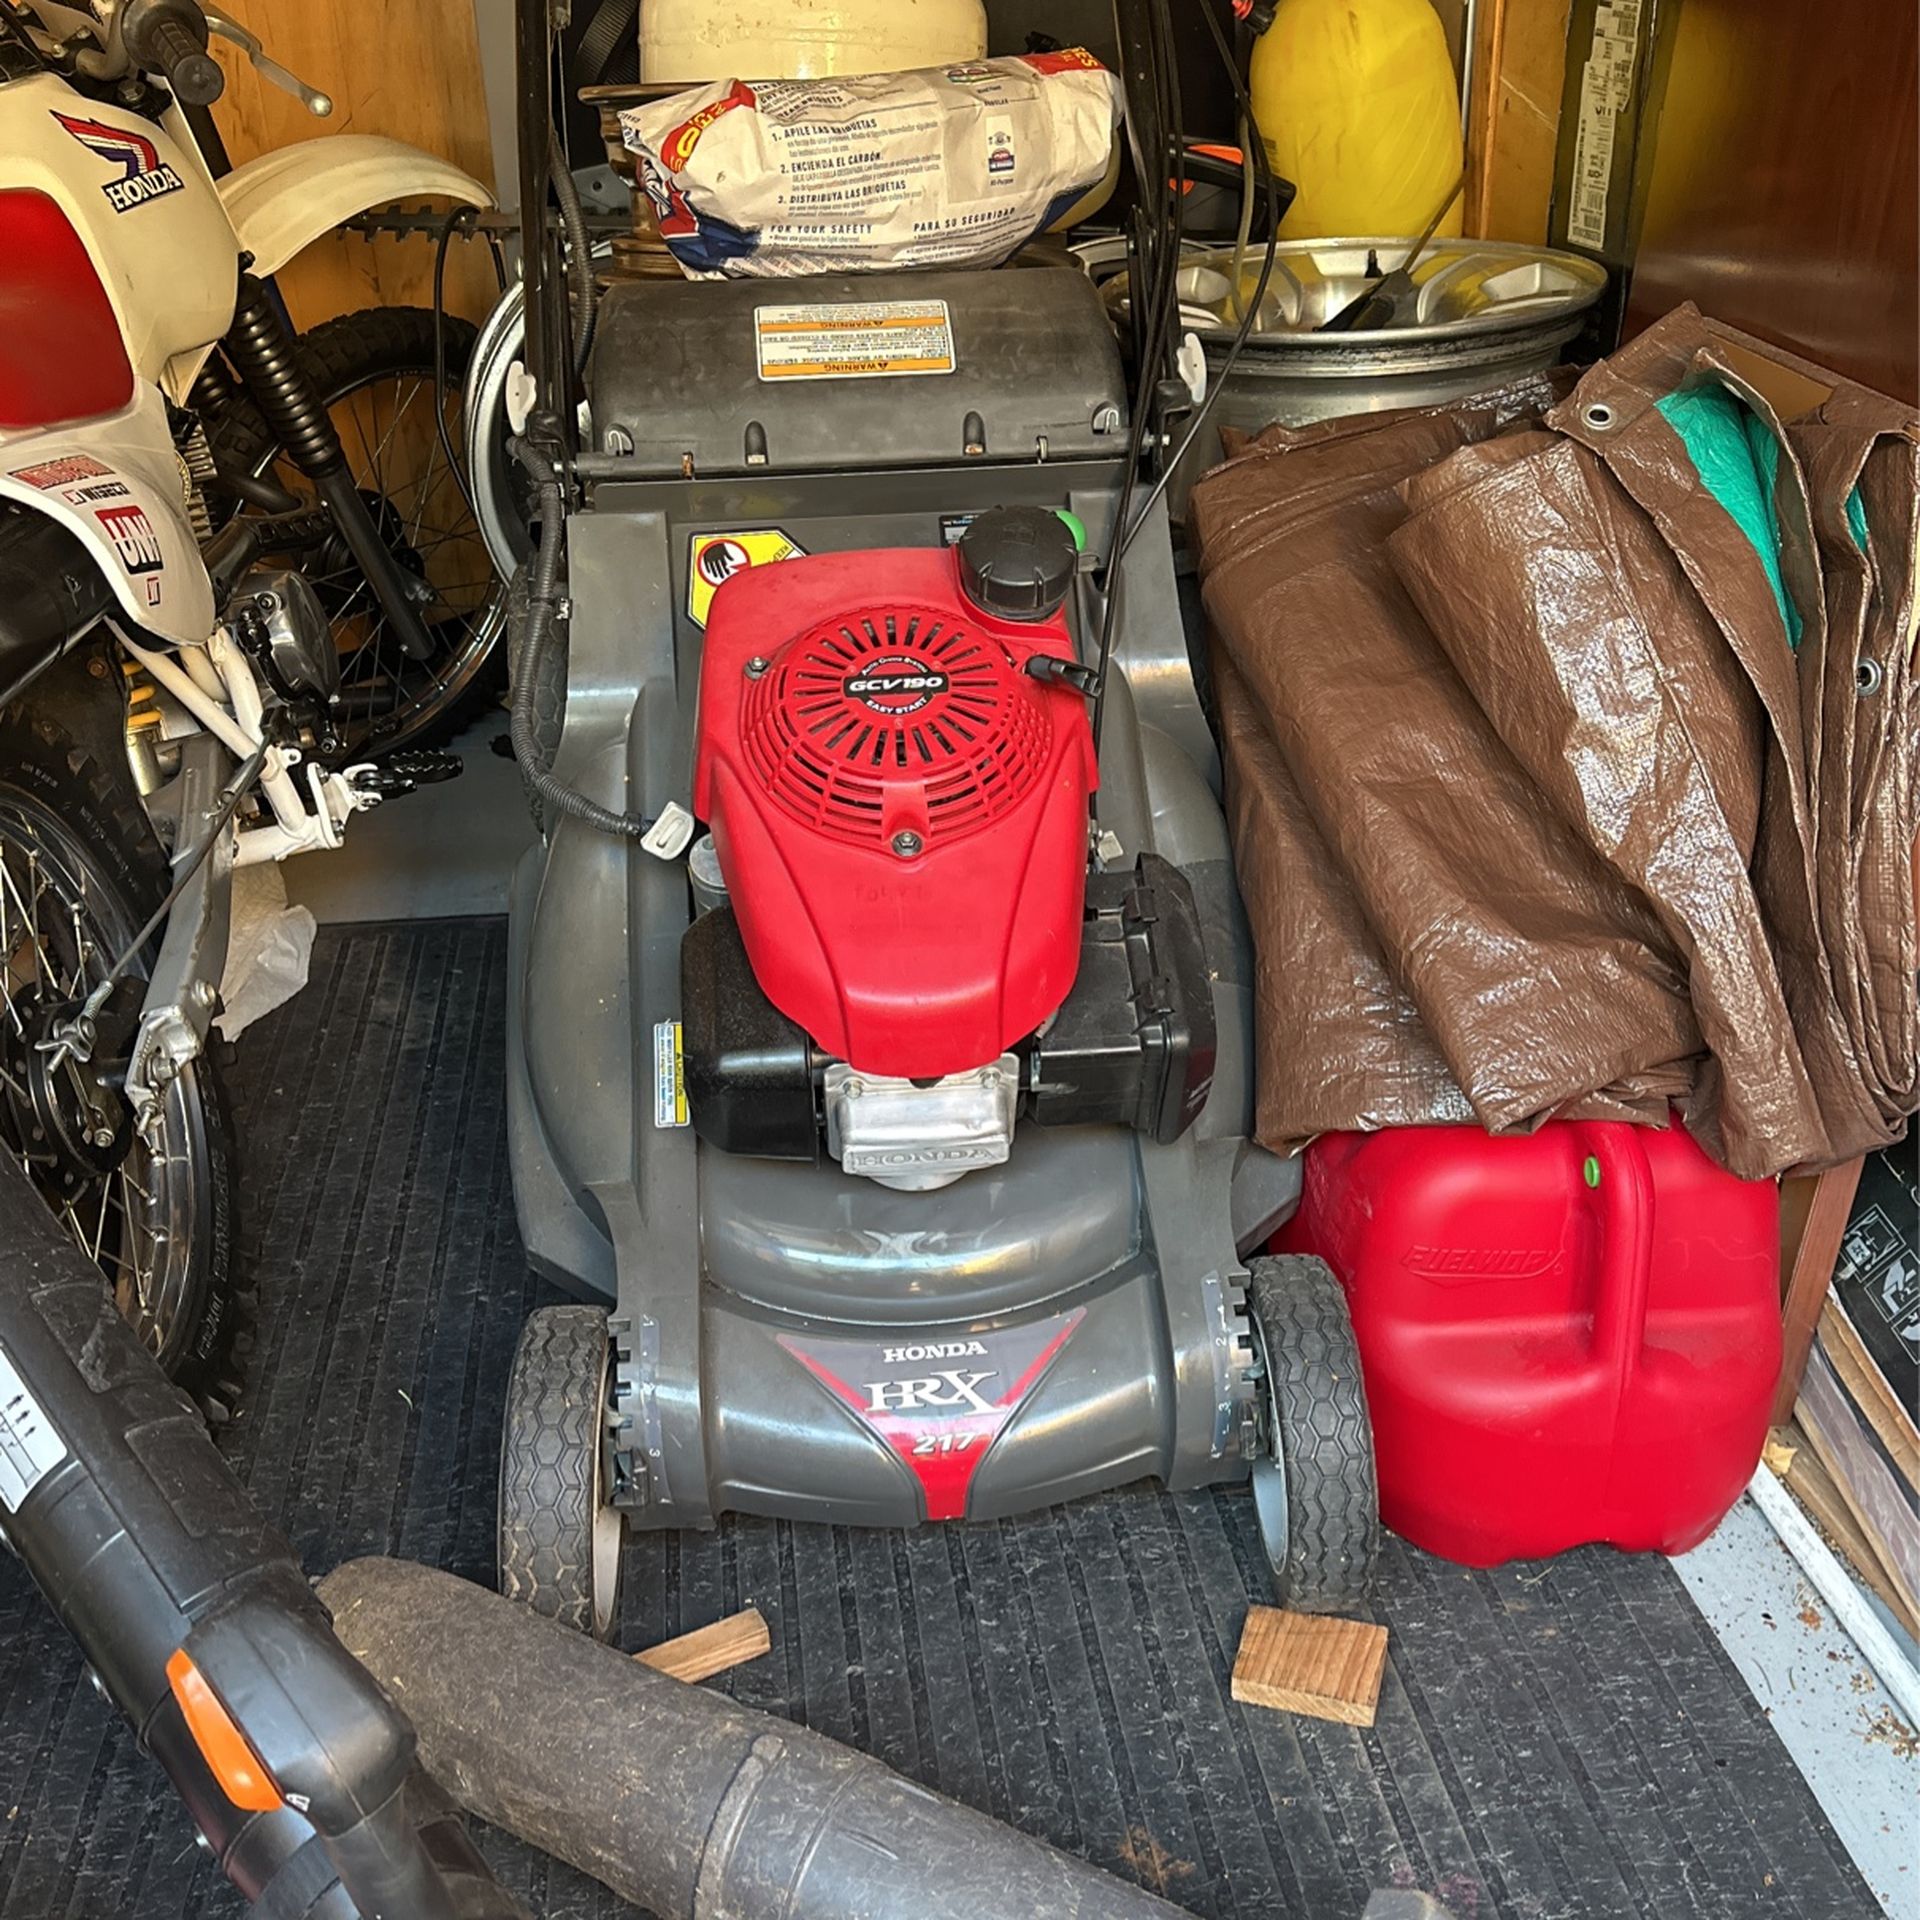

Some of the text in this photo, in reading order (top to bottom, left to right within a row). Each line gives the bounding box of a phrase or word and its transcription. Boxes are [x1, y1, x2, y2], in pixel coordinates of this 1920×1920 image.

[772, 132, 782, 142] 1.
[784, 125, 811, 138] APILE
[813, 125, 830, 136] LAS
[780, 164, 789, 174] 2.
[791, 160, 834, 173] ENCIENDA
[836, 157, 846, 167] EL
[106, 167, 182, 210] HONDA
[789, 191, 843, 205] DISTRIBUYA
[845, 187, 861, 200] LAS
[862, 180, 907, 196] BRIQUETAS
[770, 224, 873, 234] FOR YOUR SAFETY
[914, 221, 940, 232] PARA
[945, 218, 957, 228] SU
[824, 363, 877, 371] WARNING
[104, 514, 162, 567] UNI
[849, 676, 943, 692] GCV190
[866, 697, 928, 714] EASY START
[856, 1149, 1000, 1167] HONDA
[1215, 1336, 1227, 1347] 2
[883, 1341, 989, 1363] HONDA
[862, 1368, 1008, 1416] HRX
[912, 1431, 975, 1455] 217
[649, 1449, 661, 1458] 3
